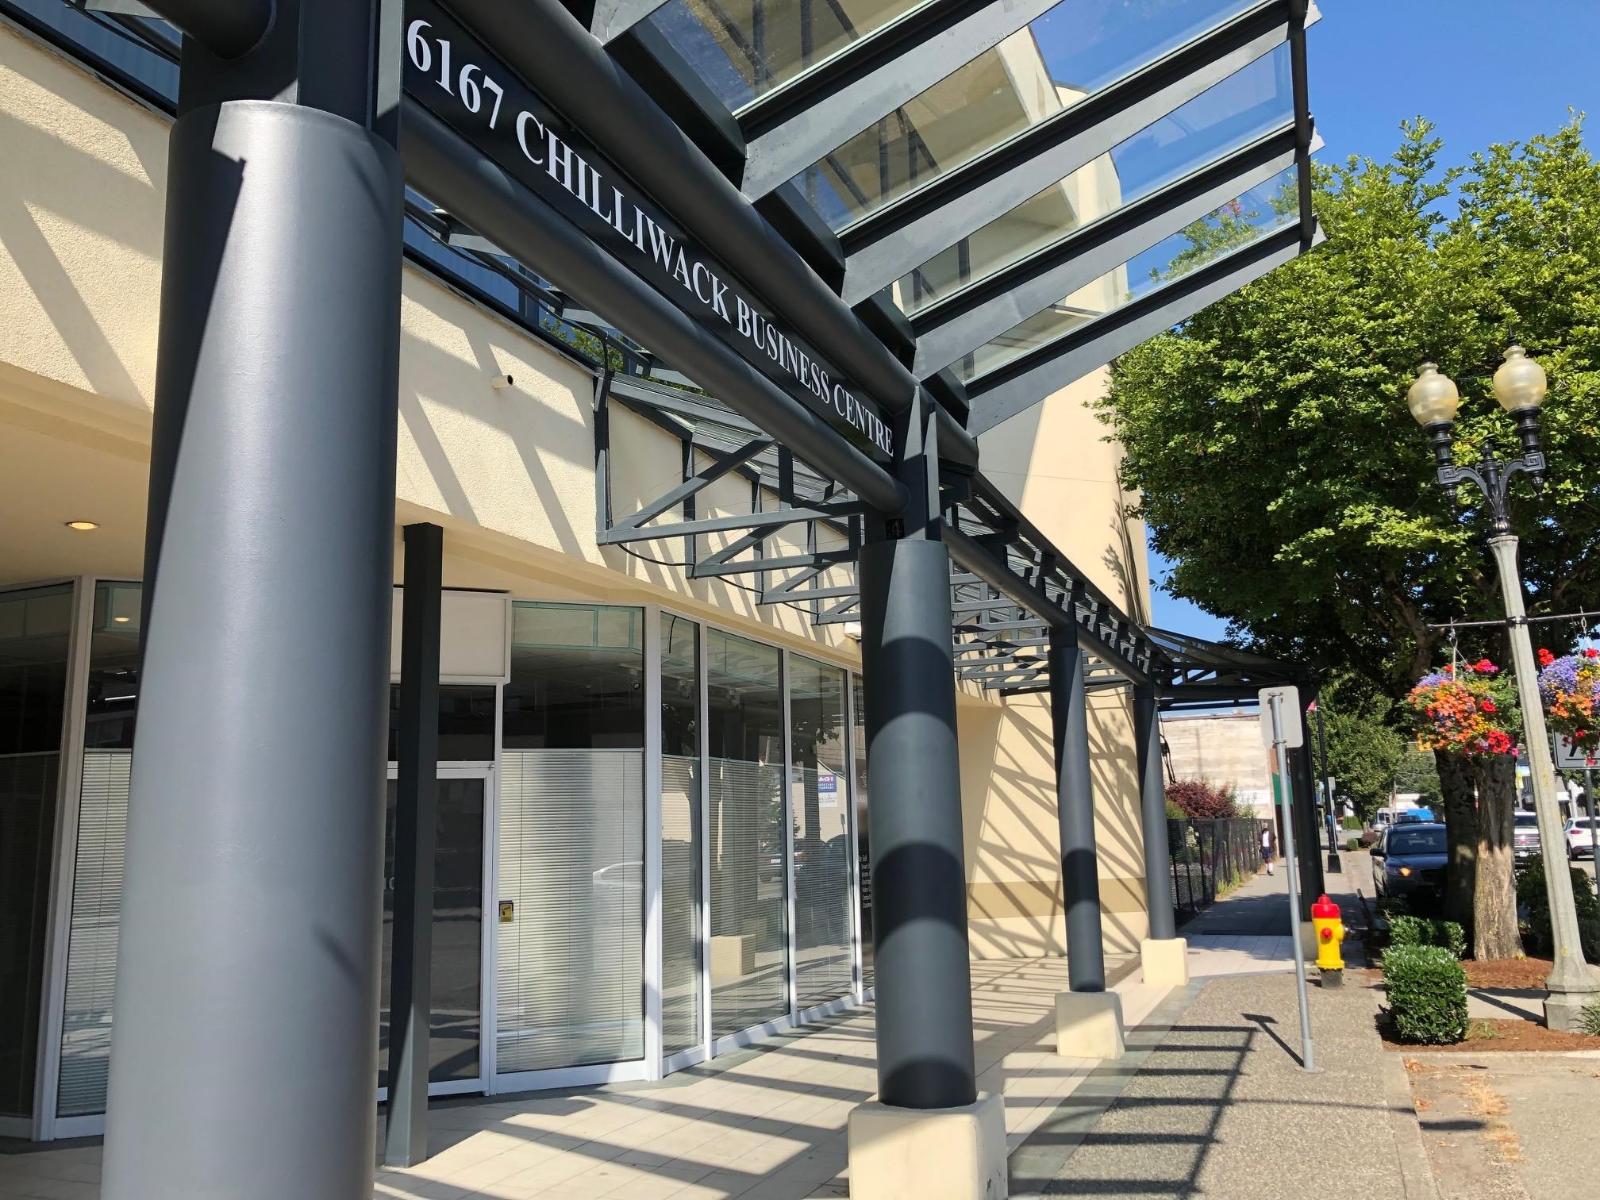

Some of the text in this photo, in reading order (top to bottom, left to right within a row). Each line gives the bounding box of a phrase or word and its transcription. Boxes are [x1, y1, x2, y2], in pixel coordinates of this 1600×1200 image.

[407, 19, 894, 457] 6167 CHILLIWACK BUSINESS CENTRE
